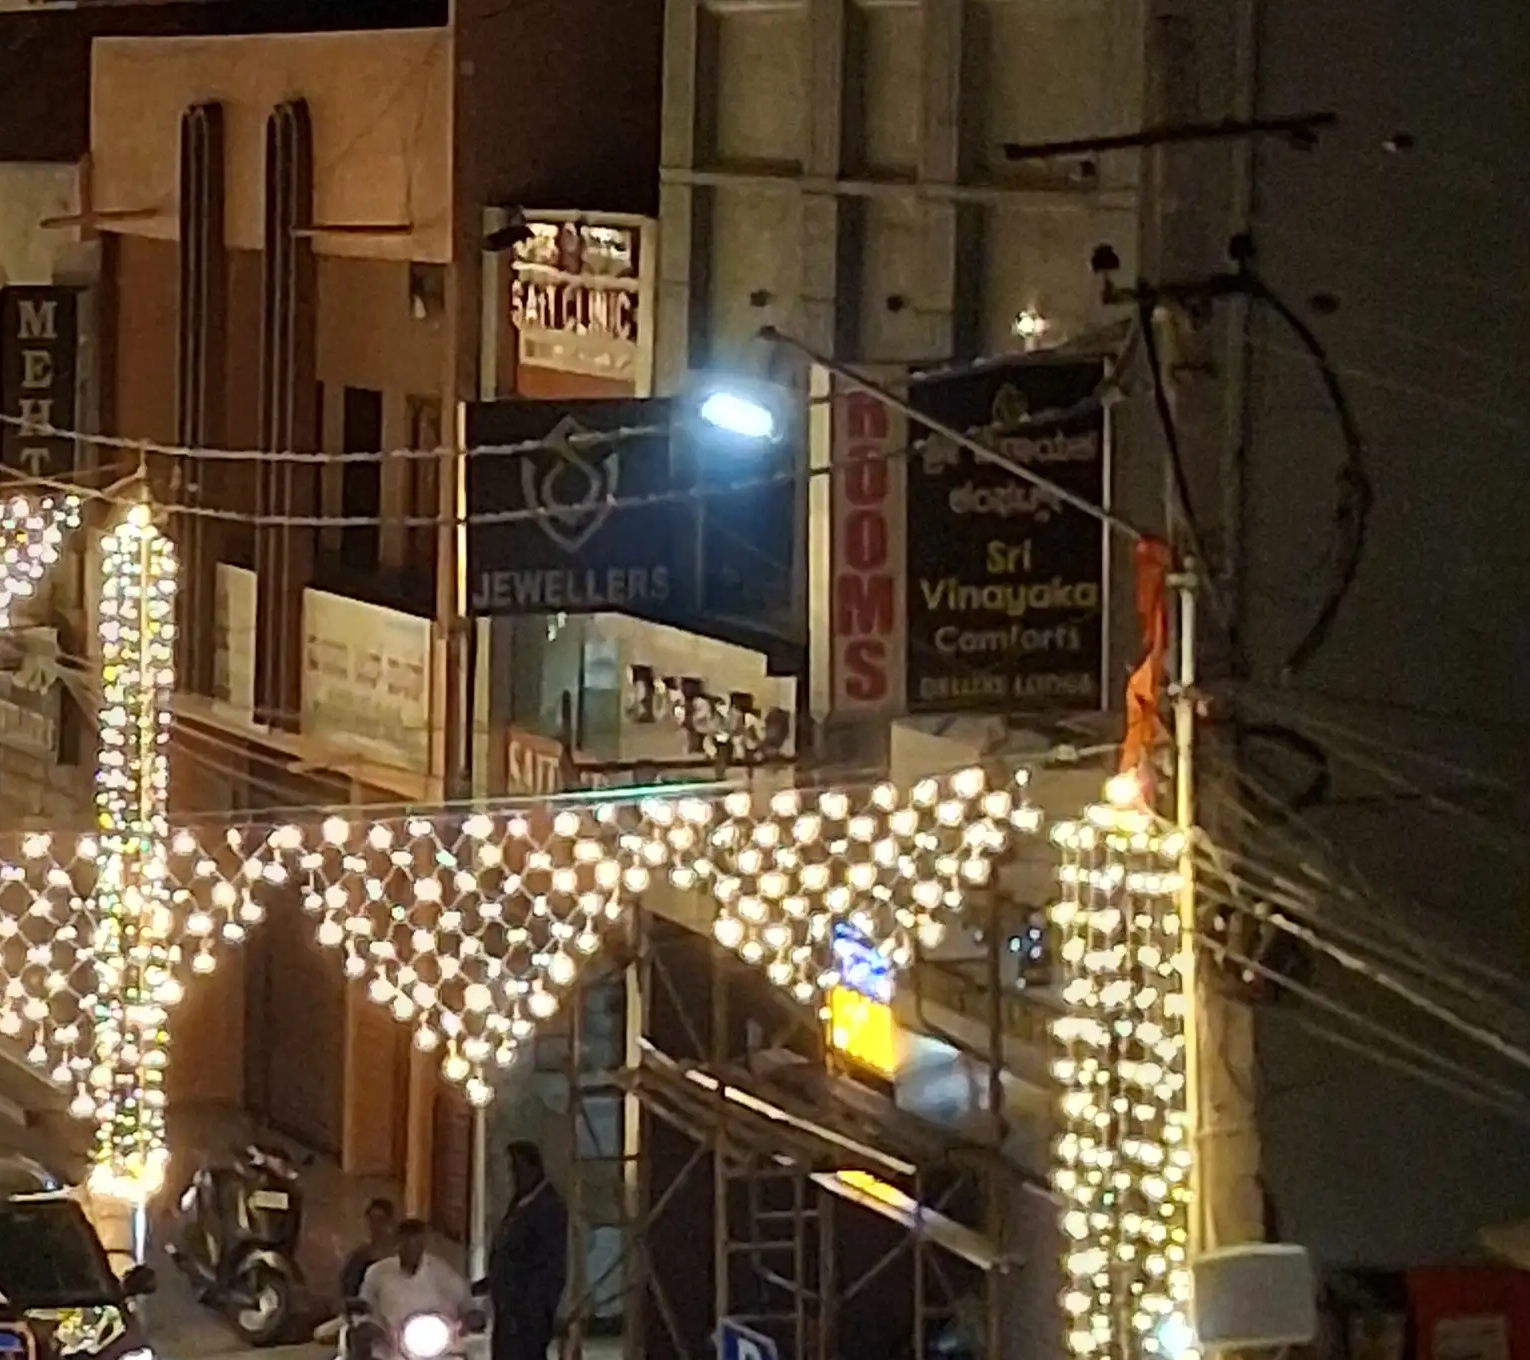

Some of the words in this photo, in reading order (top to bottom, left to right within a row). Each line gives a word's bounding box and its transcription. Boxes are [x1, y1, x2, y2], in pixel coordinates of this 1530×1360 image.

[987, 539, 1032, 574] Sri
[472, 565, 670, 607] JEWELLERS
[920, 578, 1099, 616] Vinayaka
